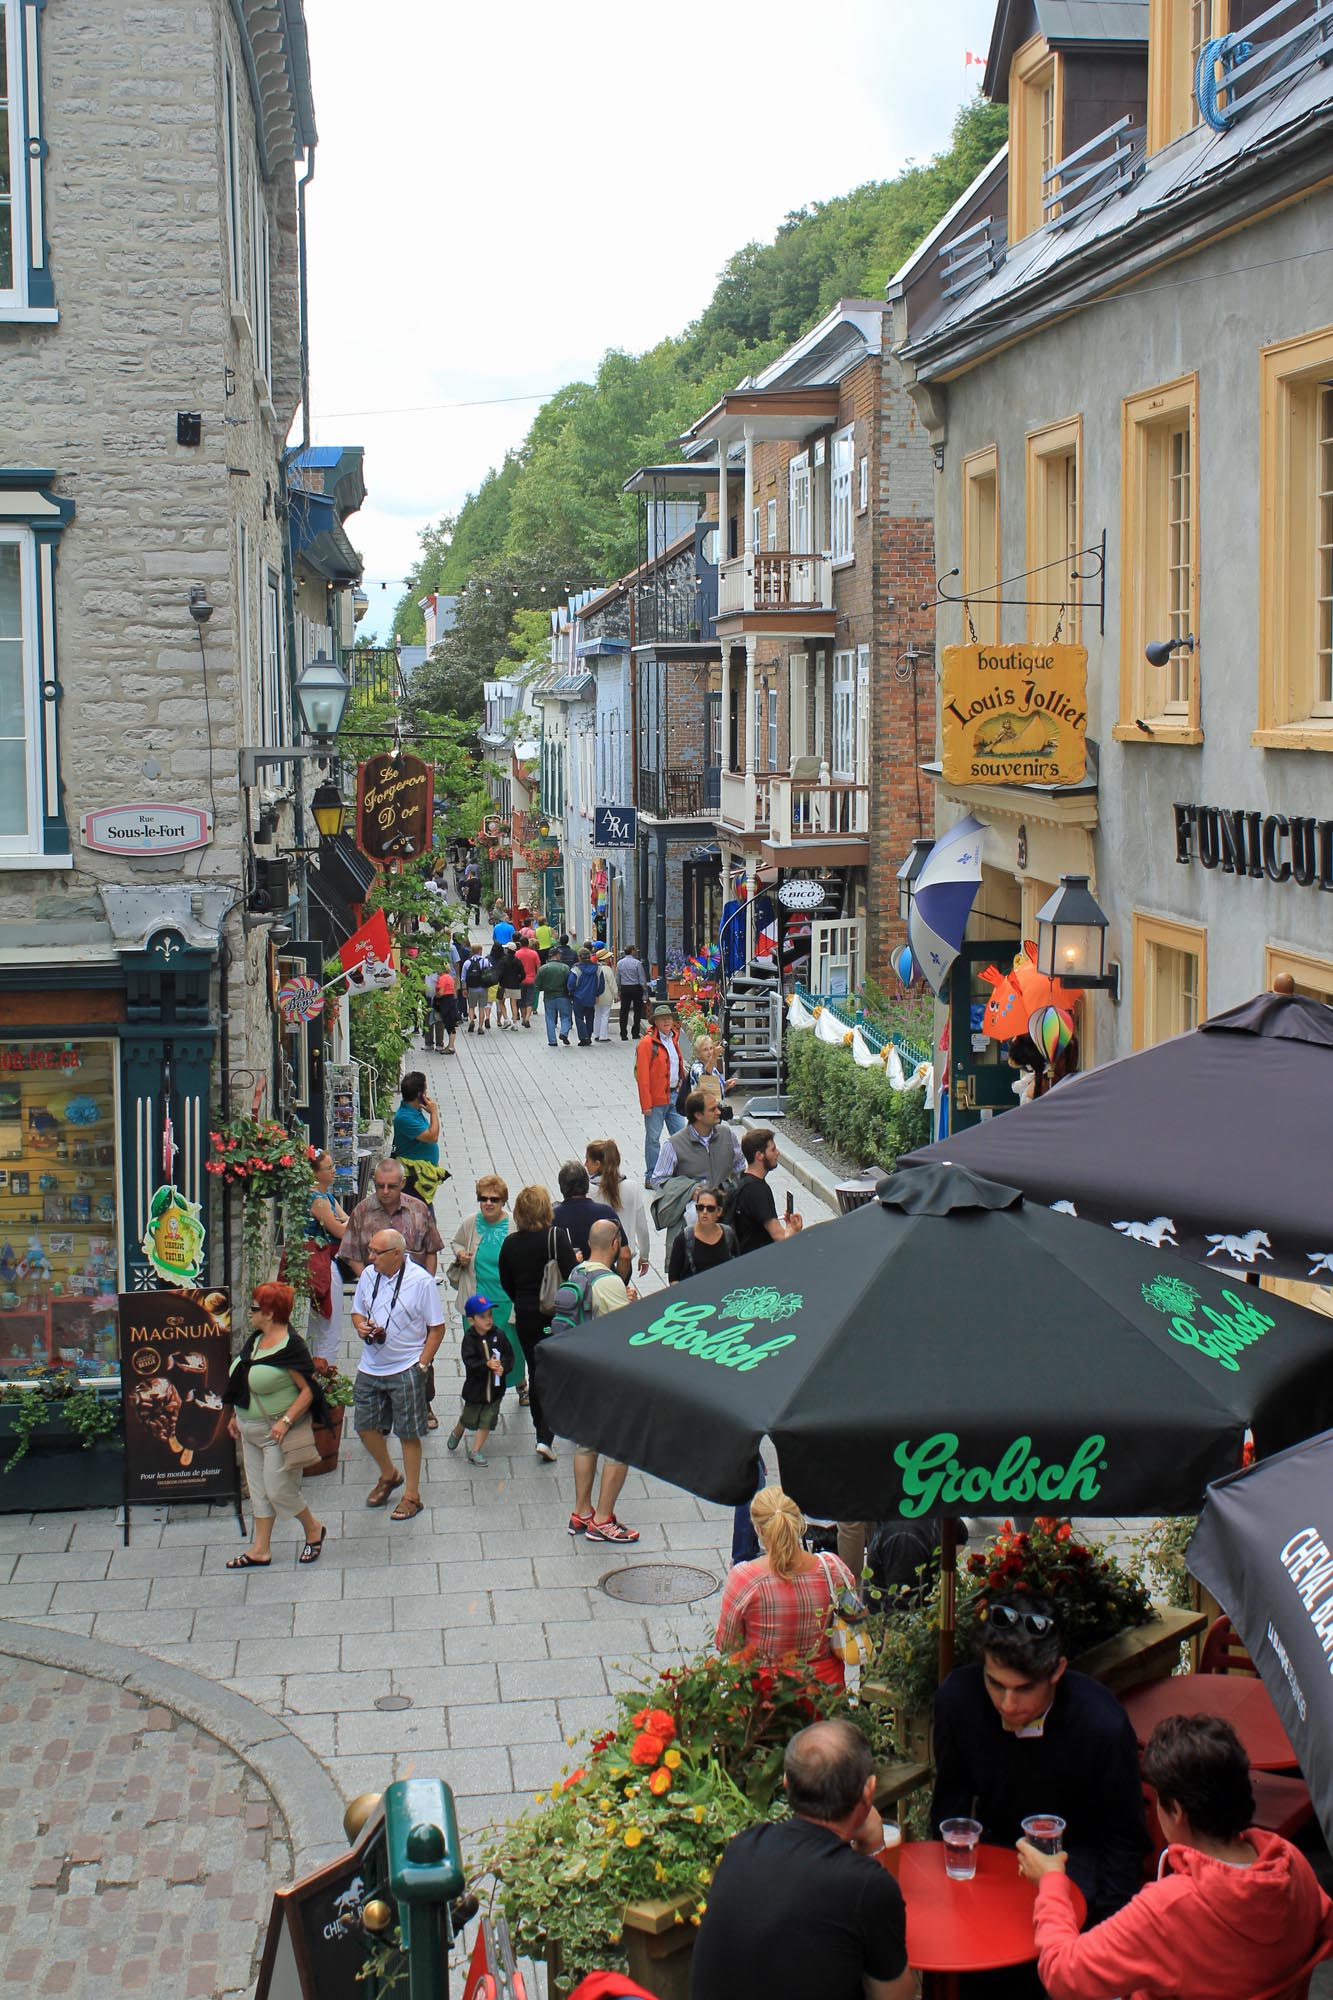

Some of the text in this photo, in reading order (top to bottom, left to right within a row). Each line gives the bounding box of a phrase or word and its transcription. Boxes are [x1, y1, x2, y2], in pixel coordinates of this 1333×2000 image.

[977, 648, 1055, 676] boutique
[944, 680, 1087, 730] Louis Jolliet
[380, 766, 399, 784] Le
[970, 758, 1060, 779] souvenirs
[364, 775, 427, 813] Forgeron
[139, 815, 155, 823] Rue
[108, 825, 185, 839] Sous-le-Fort
[296, 987, 320, 1001] Bon
[284, 996, 315, 1014] Bons
[129, 1322, 221, 1342] MAGNUM
[628, 1301, 797, 1372] Grolsch
[1168, 1289, 1276, 1371] Grolsch
[201, 1468, 221, 1477] plaisir
[893, 1432, 1106, 1519] Grolsch
